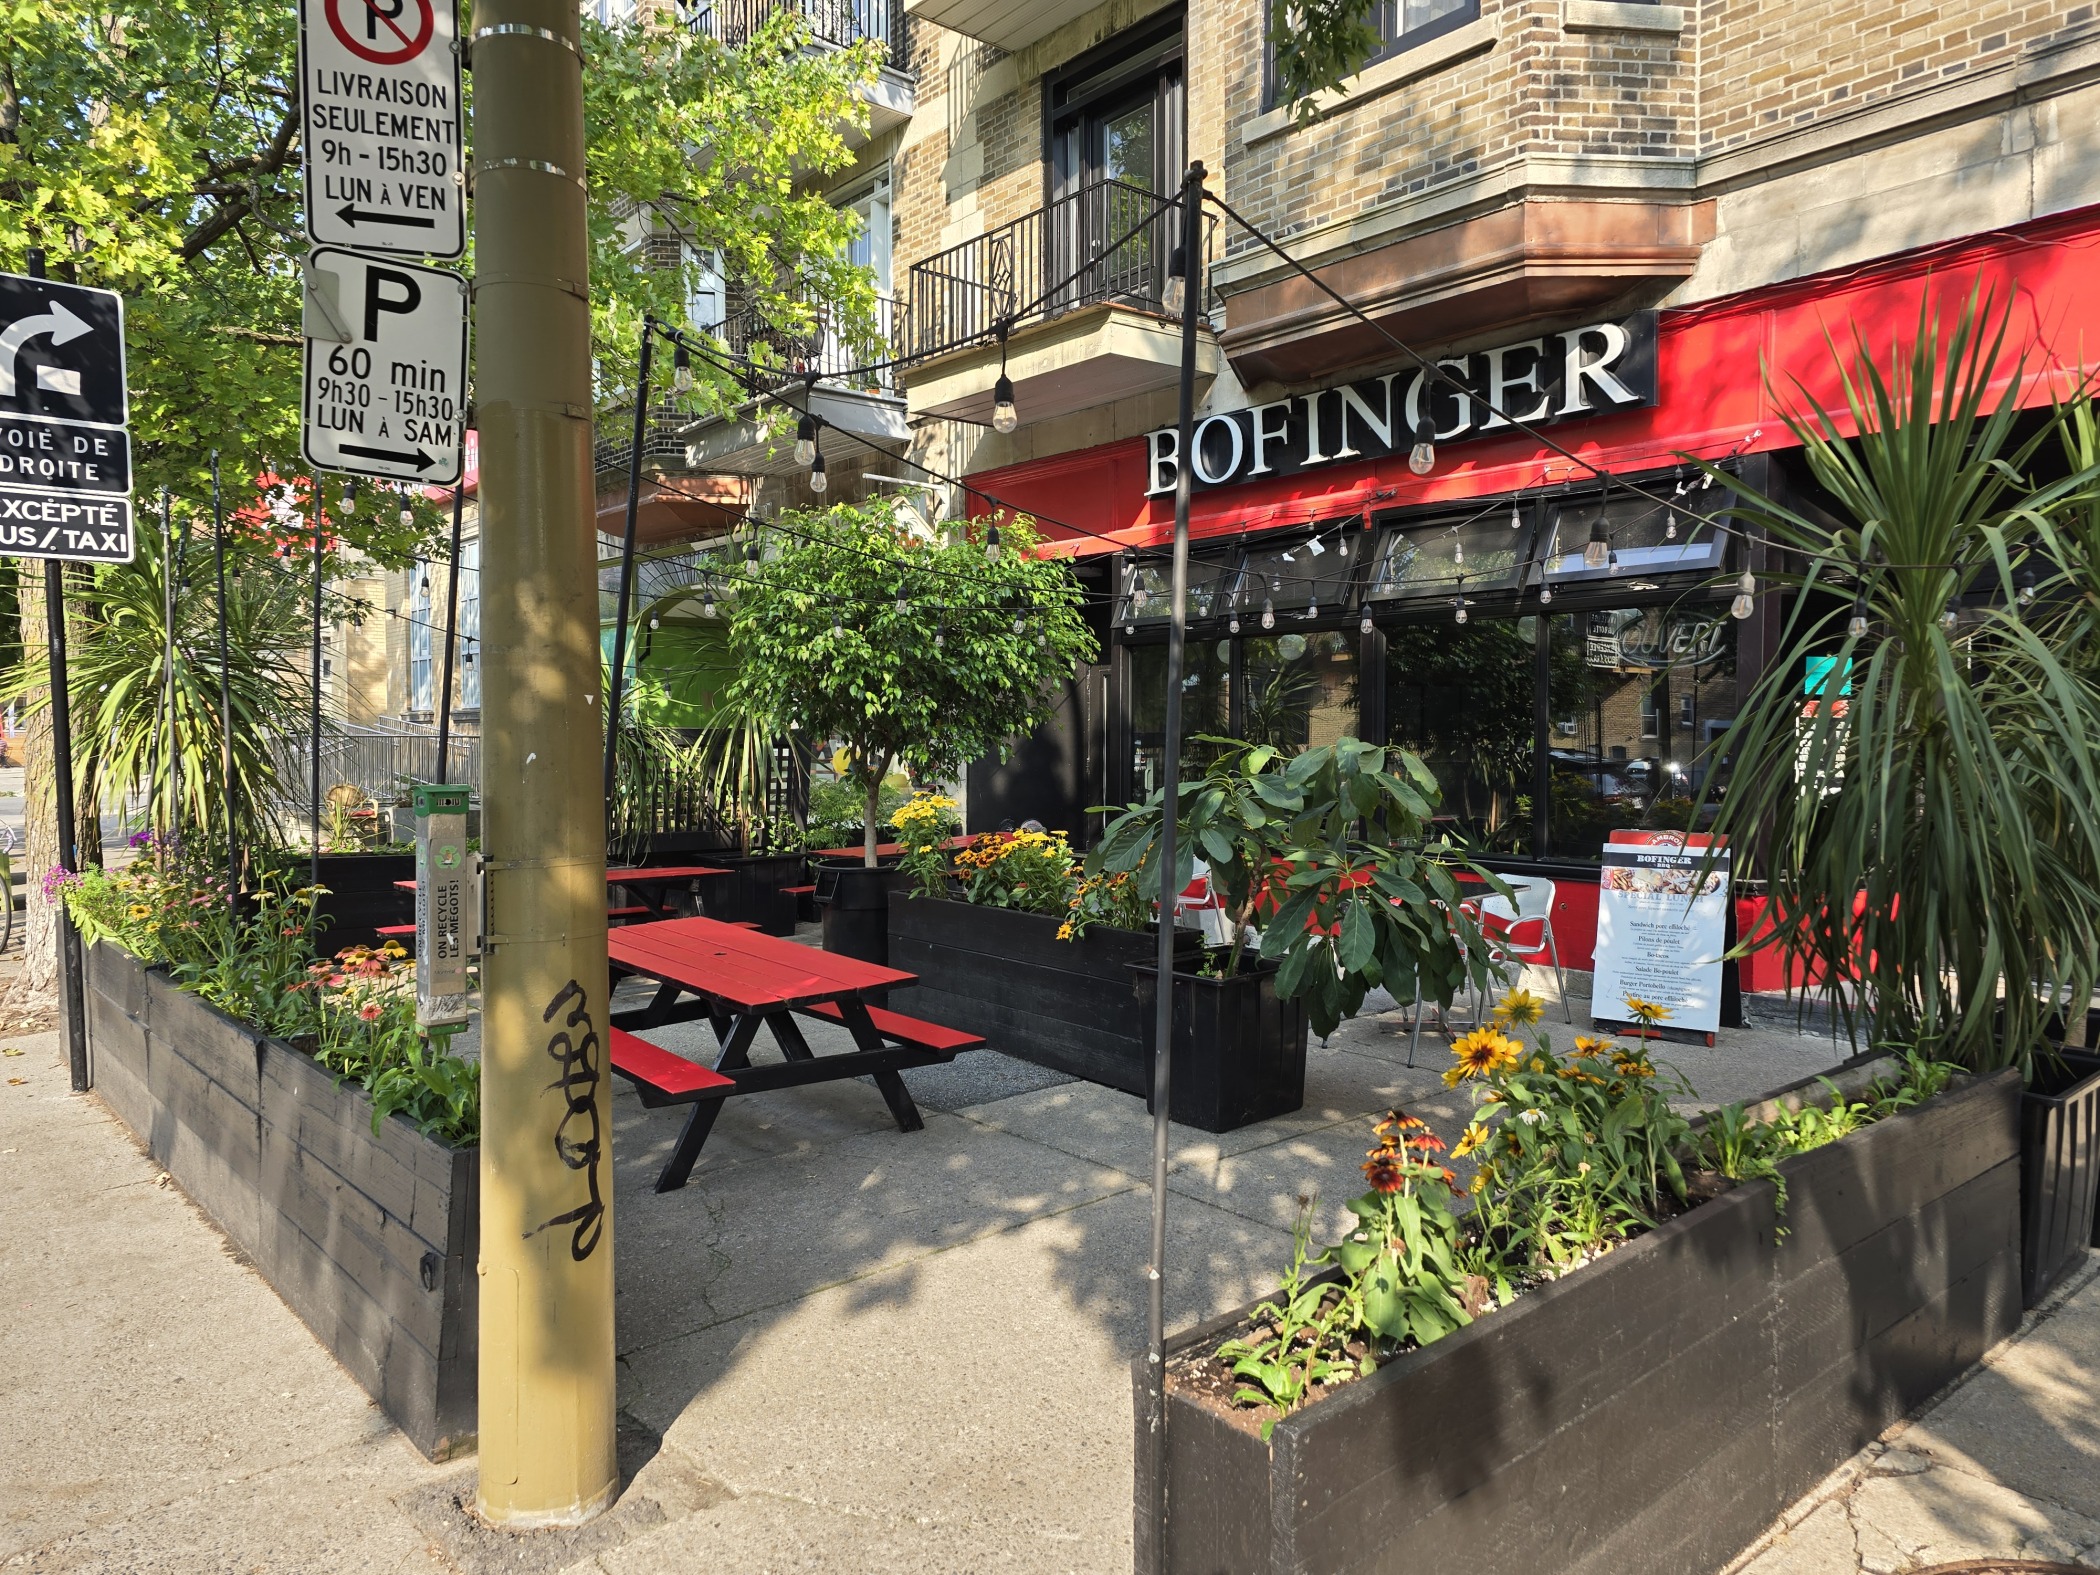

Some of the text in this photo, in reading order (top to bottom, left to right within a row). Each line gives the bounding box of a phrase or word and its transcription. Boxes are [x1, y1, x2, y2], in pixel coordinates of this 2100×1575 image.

[317, 69, 447, 109] LIVRAISON
[312, 104, 454, 144] SEULEMENT
[322, 139, 351, 166] 9h
[378, 145, 447, 177] 15h30
[325, 175, 446, 211] LUN À VEN
[364, 264, 422, 343] P
[328, 344, 446, 393] 60 min
[318, 377, 371, 408] 9h30
[395, 390, 453, 421] 15h30
[1143, 321, 1641, 497] BOFINGER
[0, 428, 109, 457] OIE DE
[317, 404, 452, 447] LUN À SAM
[0, 454, 100, 481] DROITE
[0, 498, 119, 527] XCEPTÉ
[0, 524, 127, 553] US/TAXI
[1622, 620, 1728, 654] OUVERT
[1636, 854, 1692, 865] BOFINGER
[448, 879, 459, 933] MÉGOTS!
[1667, 892, 1704, 903] LUNH
[438, 885, 448, 959] ON RECYCLE
[1629, 920, 1654, 928] Sandwich
[1620, 980, 1637, 988] Burger
[1638, 981, 1666, 989] Portobello
